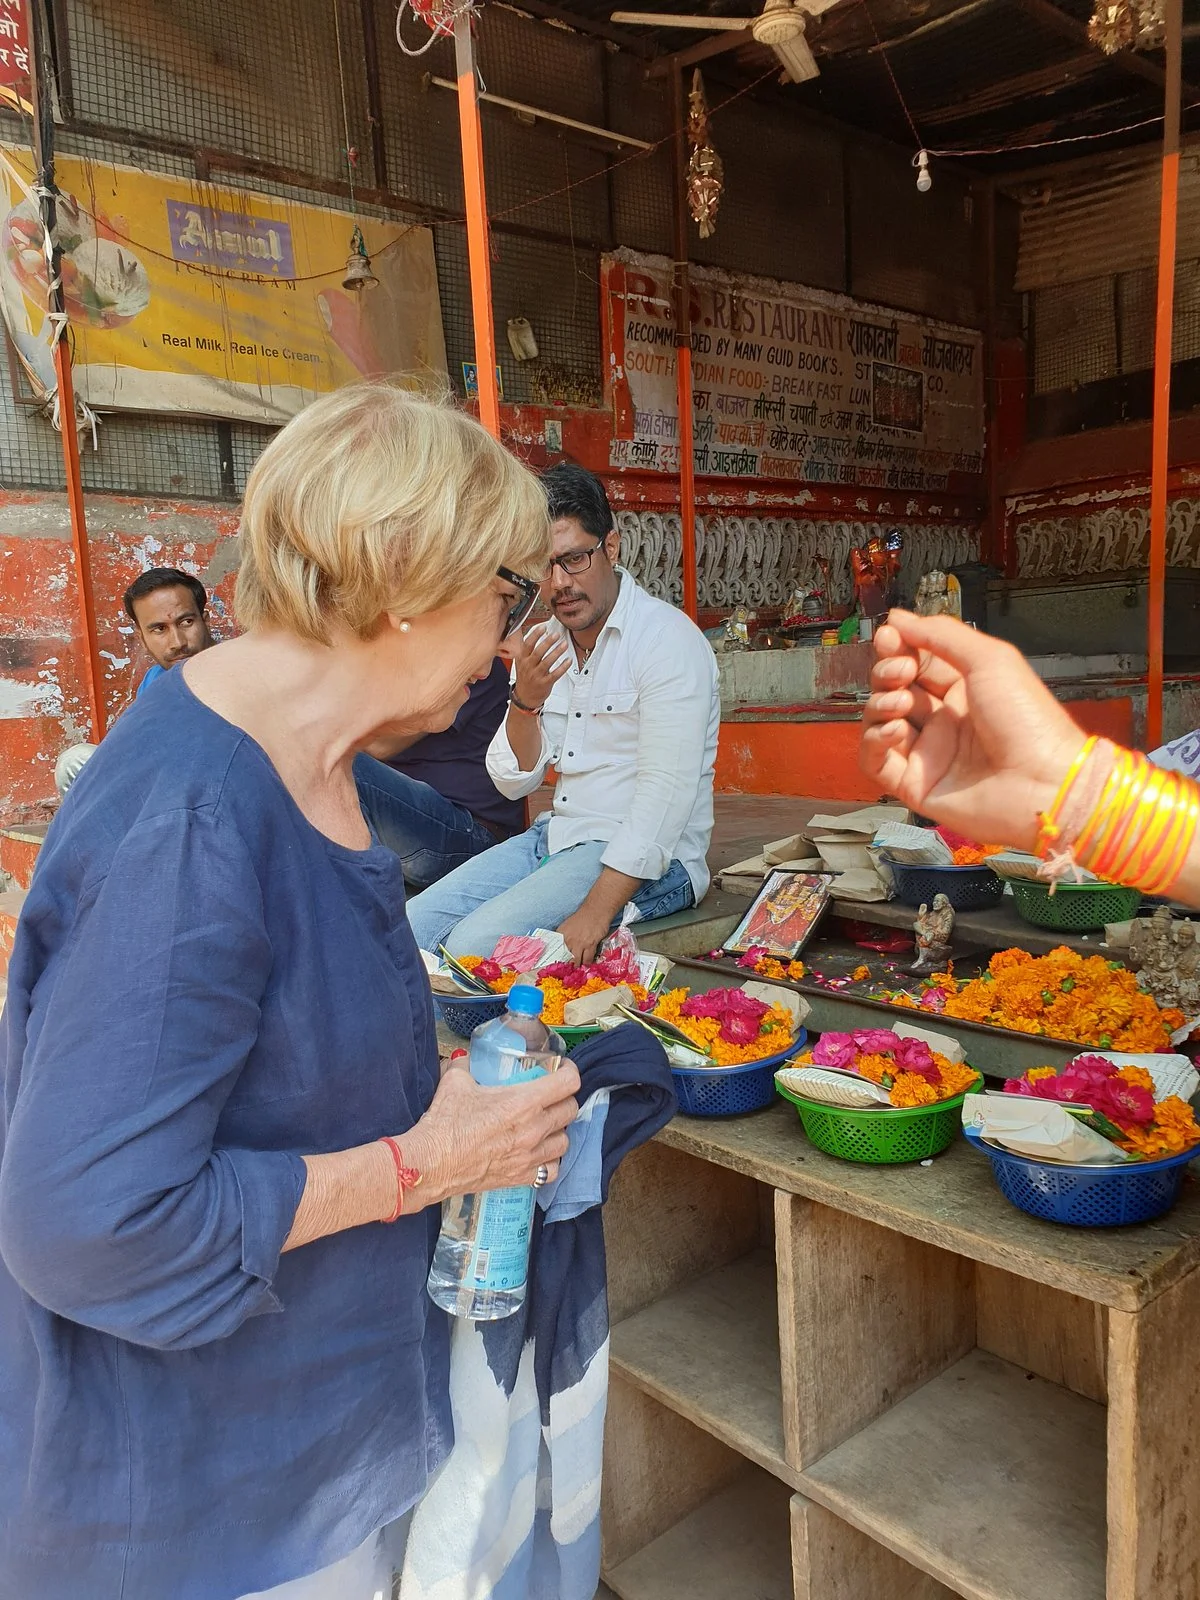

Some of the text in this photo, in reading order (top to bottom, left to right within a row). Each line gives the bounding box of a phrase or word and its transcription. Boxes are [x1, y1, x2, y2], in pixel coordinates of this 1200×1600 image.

[226, 270, 297, 291] CREAM
[626, 320, 711, 354] RECOMMEDED
[716, 336, 730, 357] BY
[733, 340, 764, 362] MANY
[767, 346, 794, 370] GUID
[713, 290, 846, 350] RESTAURANT
[162, 333, 324, 364] Real Milk. Real Ice Cream.
[625, 351, 675, 377] SOUTH
[850, 387, 871, 406] LUN
